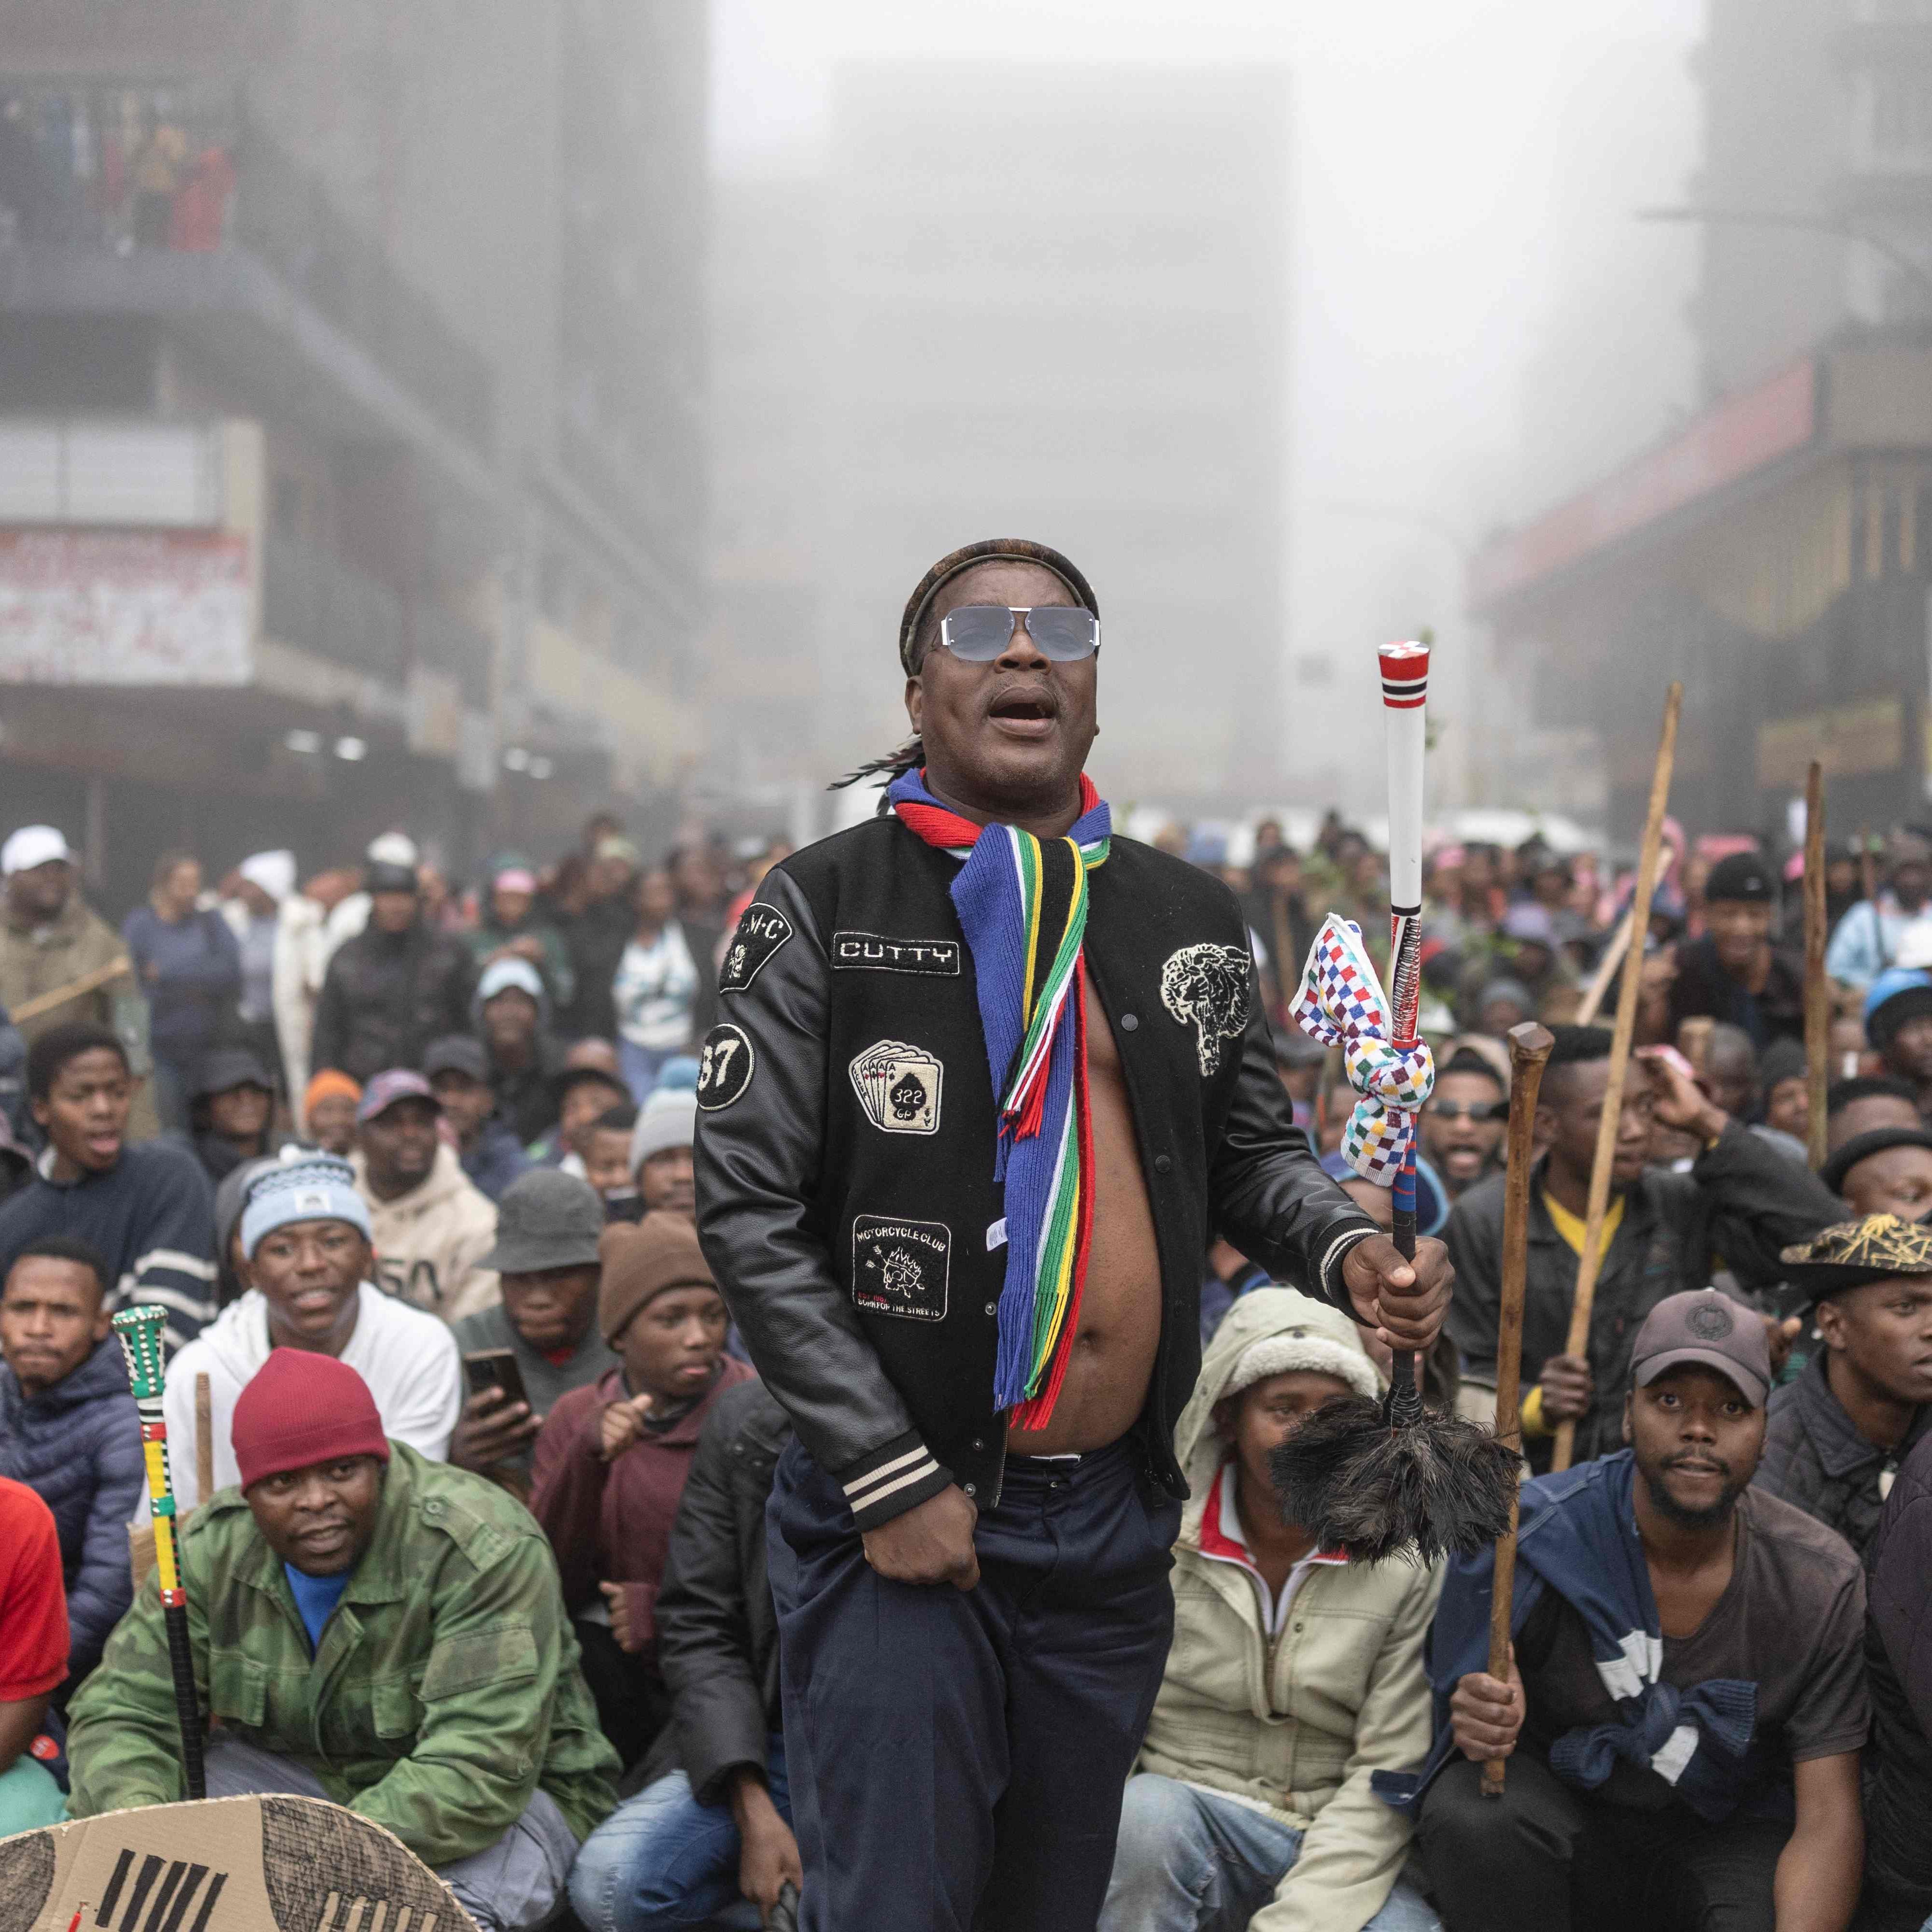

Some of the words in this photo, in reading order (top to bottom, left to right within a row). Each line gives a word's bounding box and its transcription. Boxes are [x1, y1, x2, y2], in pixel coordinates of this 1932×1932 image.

[840, 942, 952, 963] CUTTY
[895, 1089, 922, 1104] 322
[897, 1108, 911, 1118] GP
[856, 1227, 919, 1242] MOTORCYCLE
[920, 1233, 946, 1252] CLUB
[877, 1302, 890, 1310] FOR
[908, 1307, 939, 1316] STREETS
